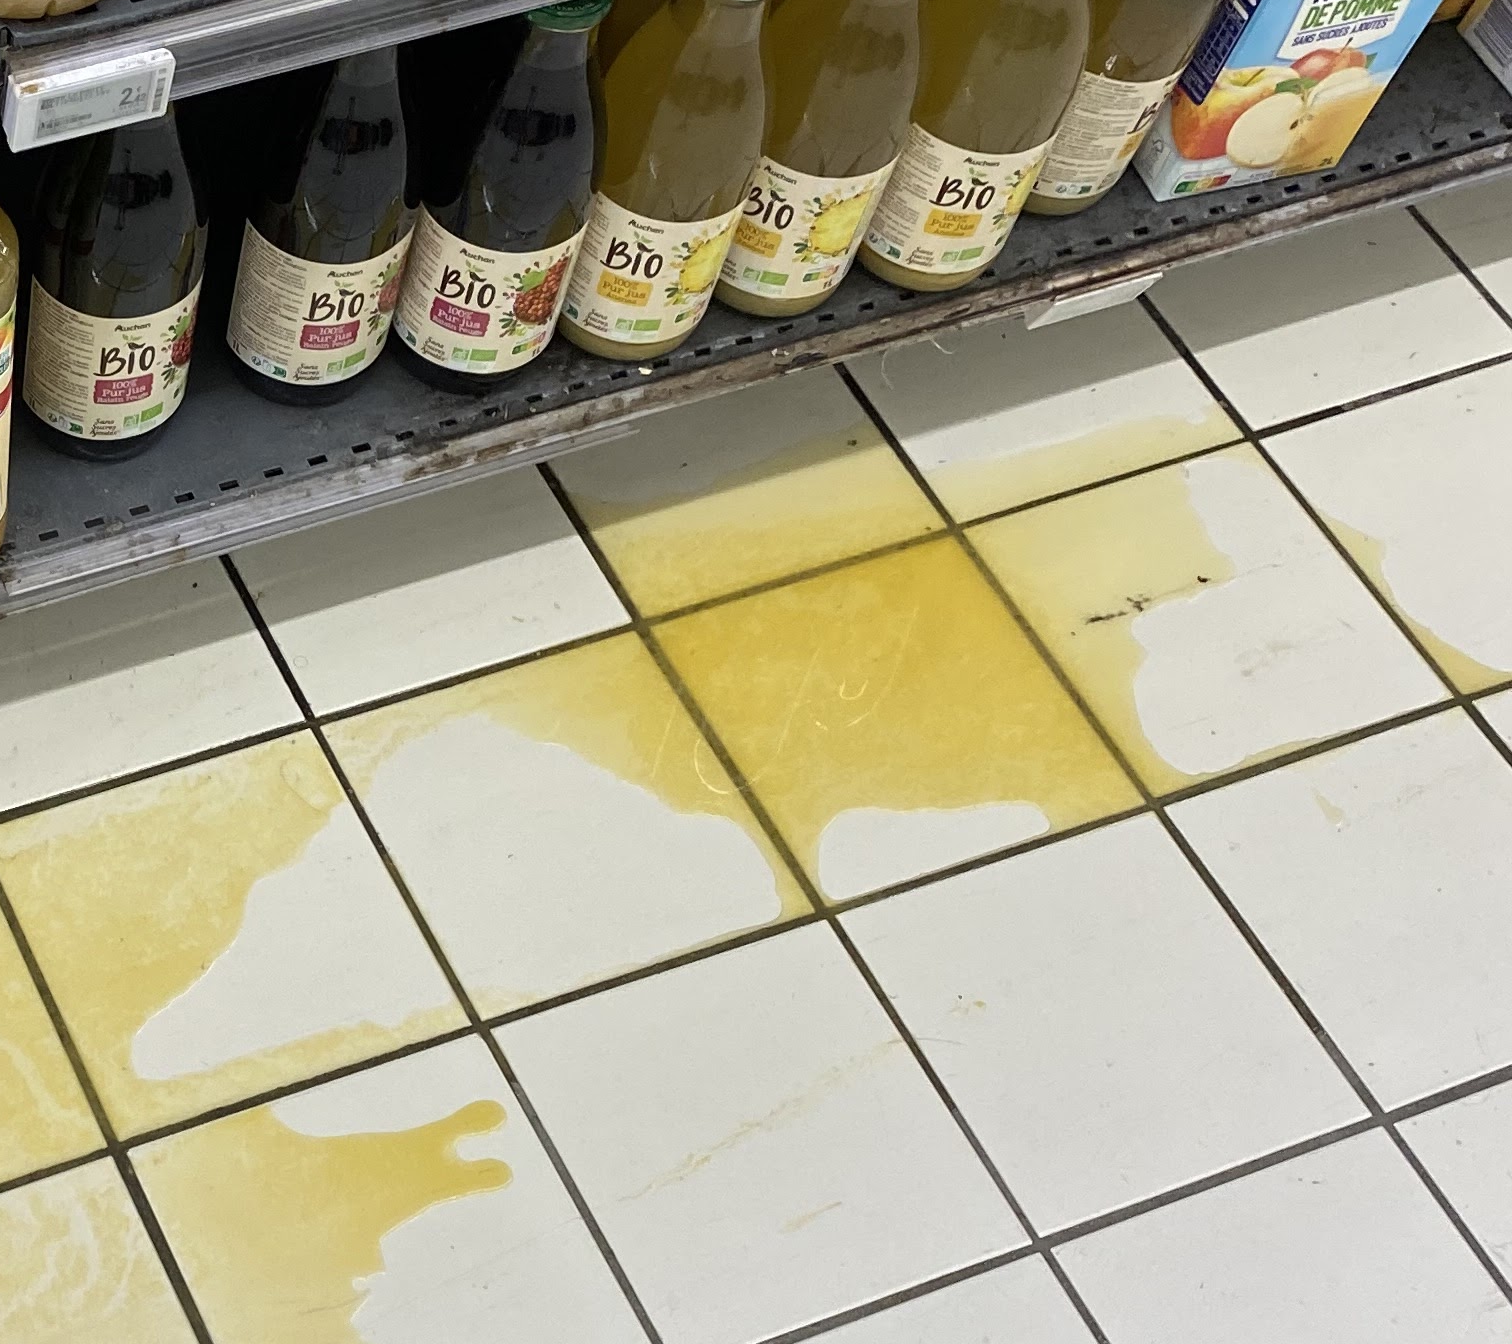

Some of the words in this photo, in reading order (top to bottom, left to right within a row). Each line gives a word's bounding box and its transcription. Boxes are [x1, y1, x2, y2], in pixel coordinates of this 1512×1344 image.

[1300, 2, 1332, 31] DE
[1291, 34, 1316, 47] SANS
[459, 247, 496, 265] Auchan
